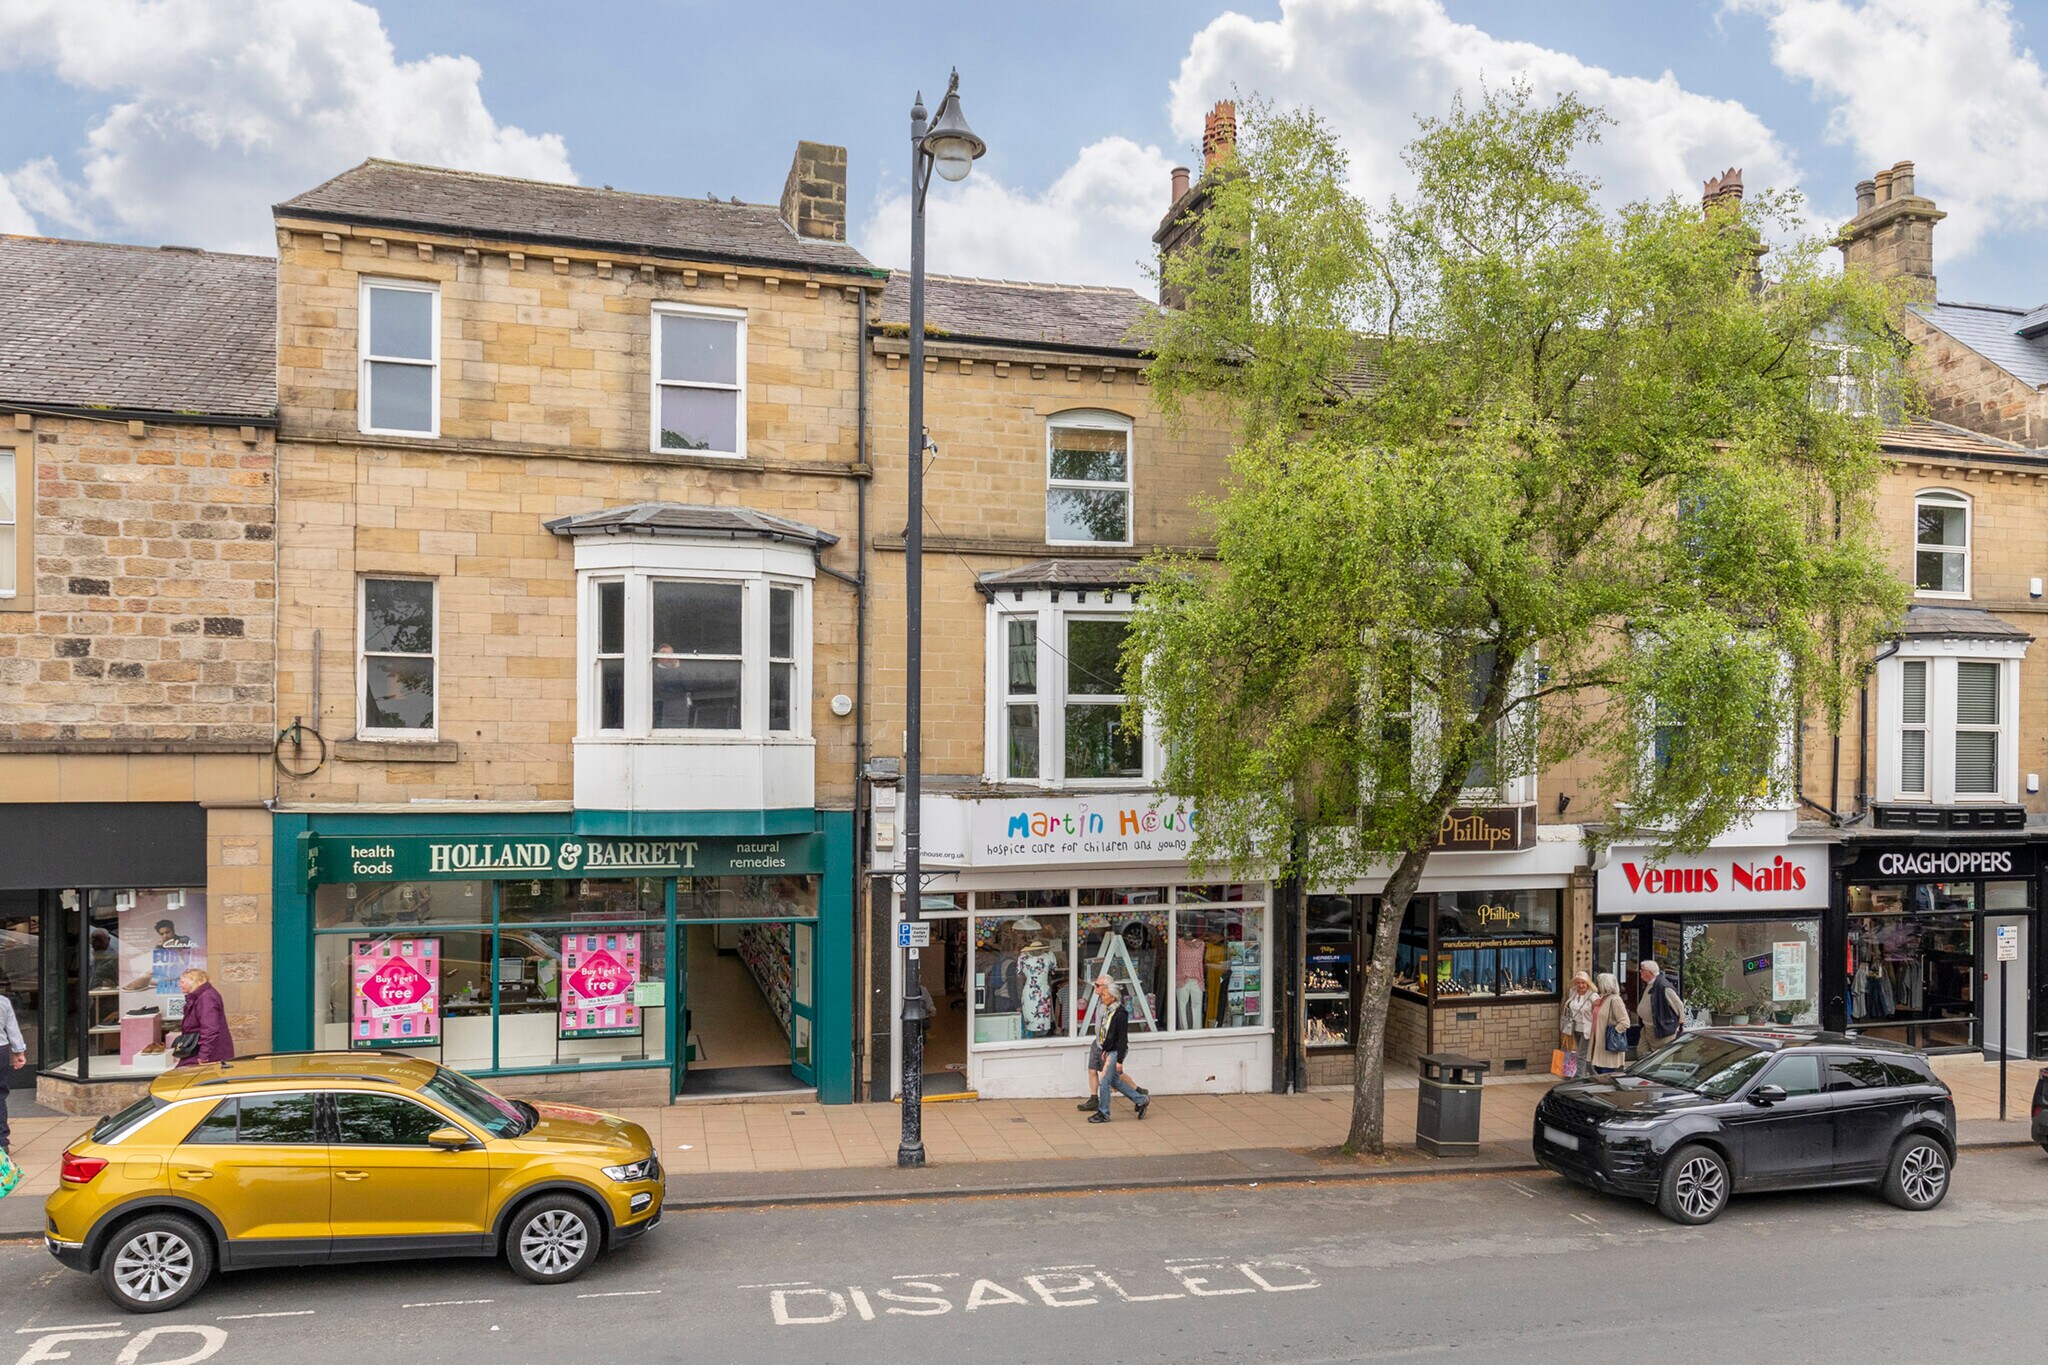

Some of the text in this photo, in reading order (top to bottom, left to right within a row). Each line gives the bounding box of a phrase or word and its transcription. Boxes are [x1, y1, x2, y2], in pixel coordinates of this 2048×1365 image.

[1007, 803, 1103, 838] Martin
[1436, 815, 1511, 850] Phillips
[351, 845, 395, 858] health
[736, 840, 780, 853] natural
[986, 839, 1187, 856] hospice care for children and young
[429, 842, 698, 872] HOLLAND & BARRETT
[903, 850, 965, 860] nhouse.org.uk
[353, 861, 393, 874] foods
[729, 856, 786, 869] remedies
[1879, 851, 2012, 875] CRAGHOPPERS
[1621, 855, 1807, 894] Venus Nails
[1477, 904, 1520, 928] Phillips
[902, 925, 909, 934] P
[162, 938, 199, 949] Clarks
[1443, 939, 1480, 949] manufacturing
[1747, 958, 1770, 971] OPEN
[581, 966, 621, 978] Buy 1 get 1
[375, 974, 418, 985] Buy 1 get 1
[586, 977, 615, 991] free
[381, 985, 412, 999] free
[768, 1260, 1322, 1326] DISABLED
